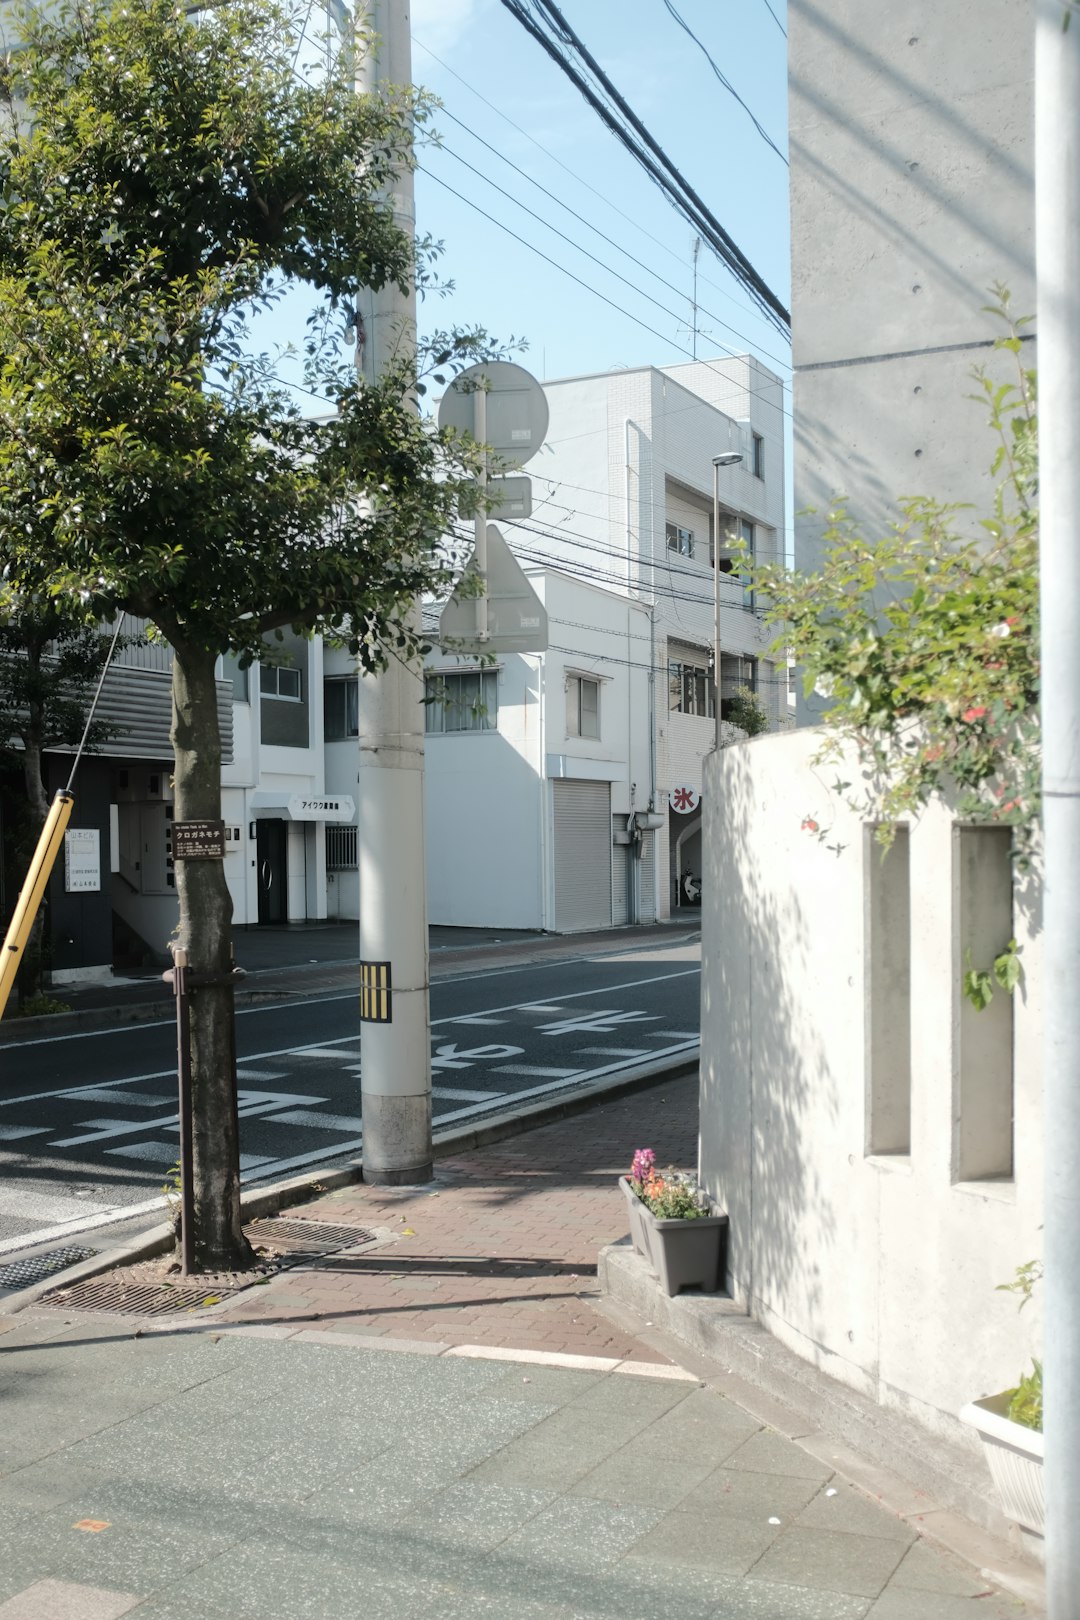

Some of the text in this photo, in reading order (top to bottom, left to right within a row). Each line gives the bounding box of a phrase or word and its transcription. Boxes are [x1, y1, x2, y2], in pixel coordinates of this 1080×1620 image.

[673, 787, 695, 811] 氷
[301, 801, 339, 810] アイワク
[71, 831, 95, 840] 山本ビル
[176, 830, 221, 840] クロガネモチ
